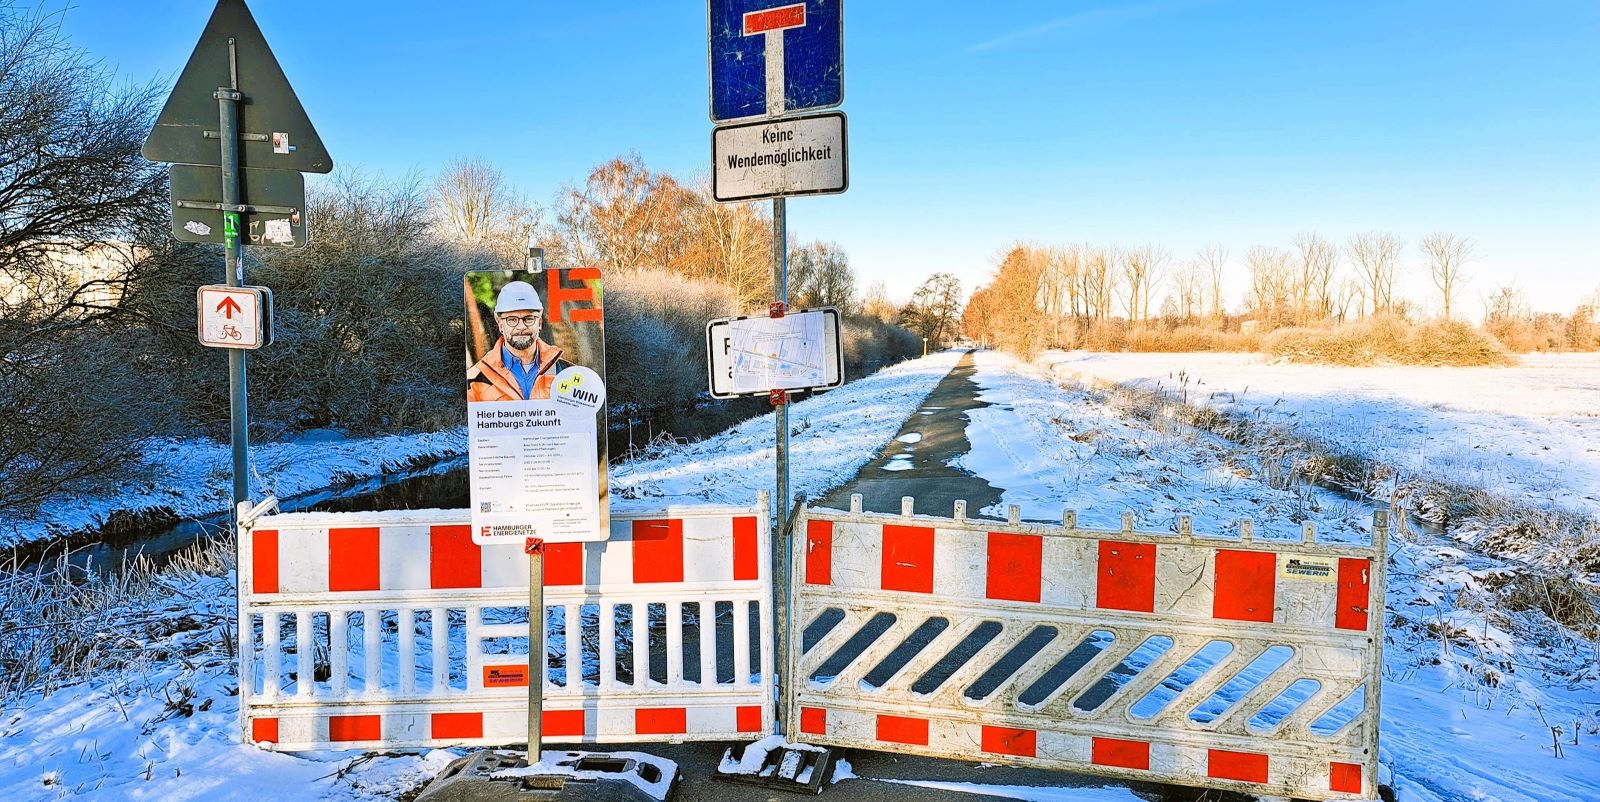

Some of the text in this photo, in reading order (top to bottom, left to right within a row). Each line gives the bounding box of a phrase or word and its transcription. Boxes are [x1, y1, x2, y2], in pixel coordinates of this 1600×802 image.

[762, 129, 794, 144] Keine
[727, 145, 832, 170] Wendemöglichkeit
[573, 375, 581, 383] H
[572, 388, 599, 404] WIN
[477, 409, 556, 419] Hier bauen wir an
[477, 418, 562, 430] Hamburgs Zukunft
[493, 529, 537, 537] ENERGIENETZE
[1286, 568, 1330, 577] SEWERIN
